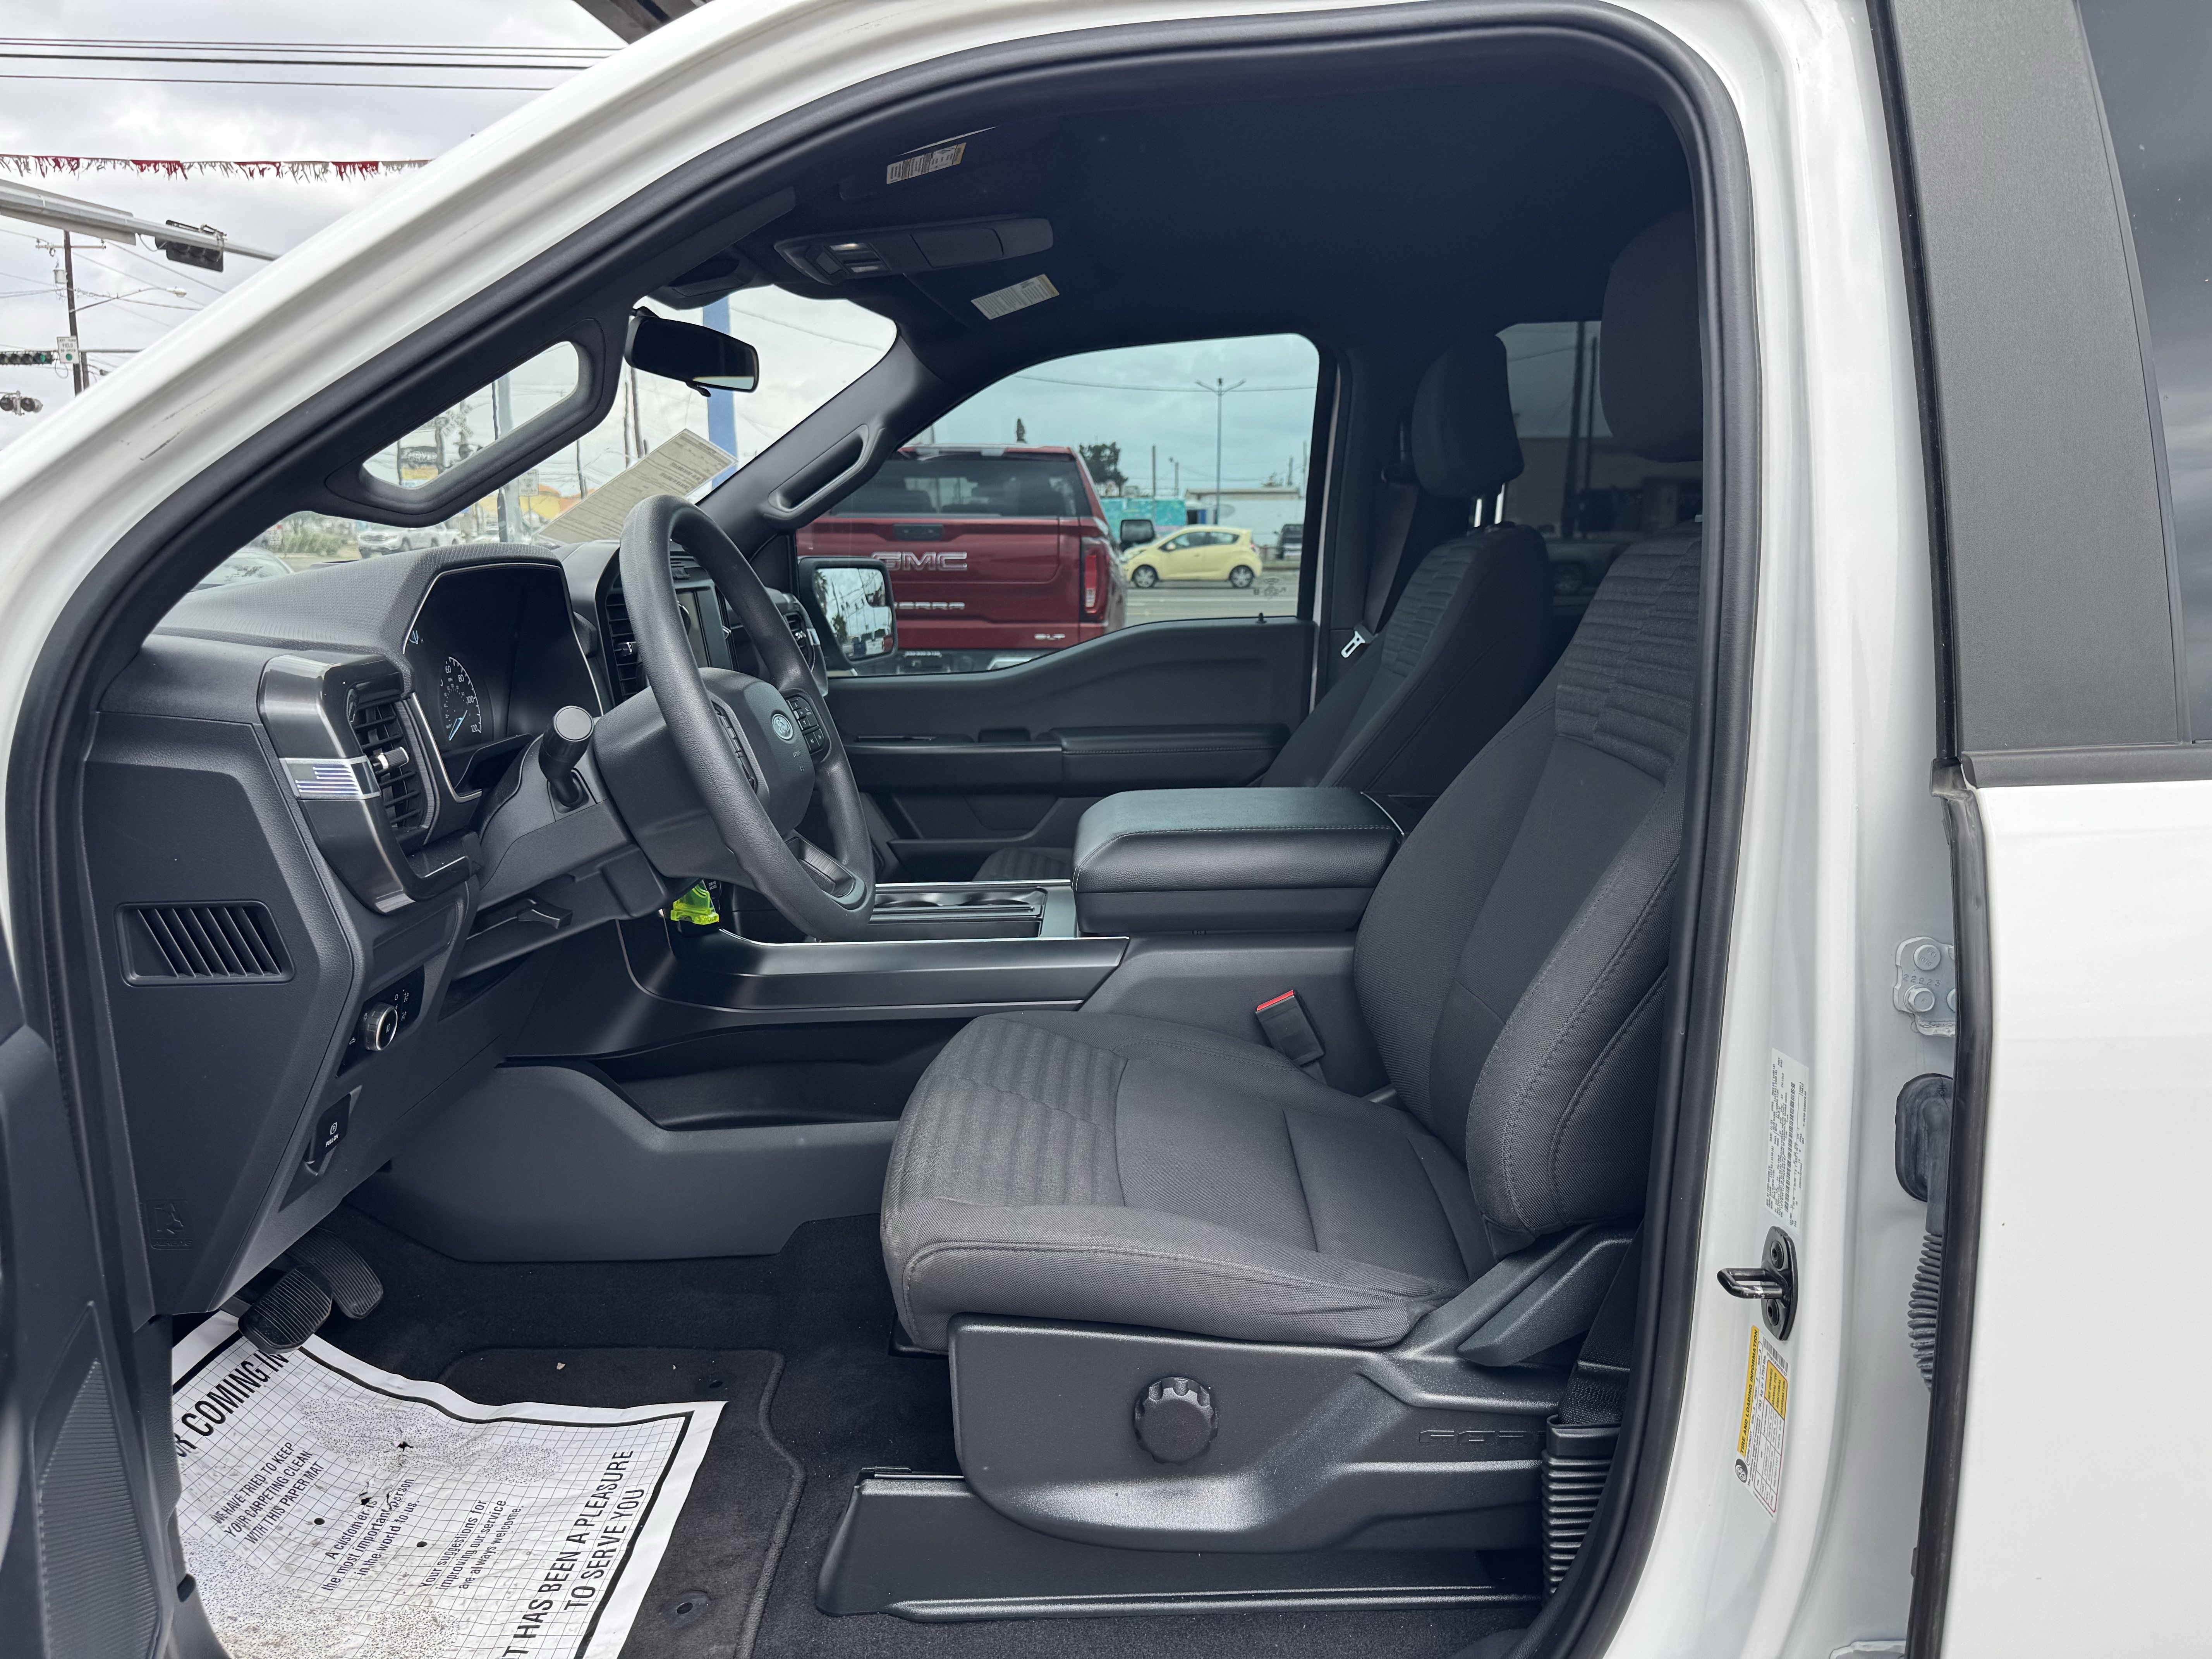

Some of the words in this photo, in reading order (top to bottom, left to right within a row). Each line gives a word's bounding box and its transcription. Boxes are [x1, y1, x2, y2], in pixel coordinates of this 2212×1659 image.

[872, 551, 967, 571] GMC
[893, 601, 965, 610] IERRA
[445, 665, 451, 673] 60
[458, 674, 464, 683] 80
[181, 1361, 270, 1436] COMING
[253, 1350, 289, 1372] IN
[1749, 1329, 1757, 1383] INFORMATION
[211, 1511, 228, 1524] WE
[221, 1494, 246, 1515] HAVE
[239, 1474, 266, 1496] TRIED
[260, 1462, 277, 1475] TO
[272, 1442, 294, 1464] KEEP
[224, 1515, 251, 1537] YOUR
[245, 1476, 290, 1518] CARPETING
[283, 1450, 313, 1477] CLEAN
[244, 1523, 268, 1544] WITH
[261, 1505, 285, 1525] THIS
[280, 1479, 310, 1506] PAPER
[303, 1461, 324, 1480] MAT
[574, 1450, 634, 1527] PLEASURE
[321, 1577, 341, 1590] the
[337, 1553, 360, 1574] most
[352, 1509, 391, 1552] important
[390, 1479, 414, 1508] person
[325, 1552, 339, 1560] A
[334, 1511, 370, 1550] customer
[354, 1566, 370, 1576] in
[362, 1553, 382, 1566] the
[376, 1525, 402, 1551] world
[394, 1515, 409, 1523] to
[407, 1501, 420, 1513] us.
[418, 1568, 442, 1588] Your
[437, 1517, 478, 1565] suggestions
[470, 1500, 487, 1514] for
[435, 1550, 477, 1589] improving
[470, 1535, 486, 1547] our
[481, 1500, 506, 1533] service
[459, 1577, 476, 1589] are
[470, 1546, 497, 1574] always
[491, 1506, 524, 1544] welcome.
[538, 1552, 581, 1593] BEEN
[564, 1586, 596, 1611] TO
[581, 1525, 627, 1579] SERVE
[610, 1489, 644, 1520] YOU
[566, 1532, 590, 1544] A
[513, 1599, 553, 1638] HAS
